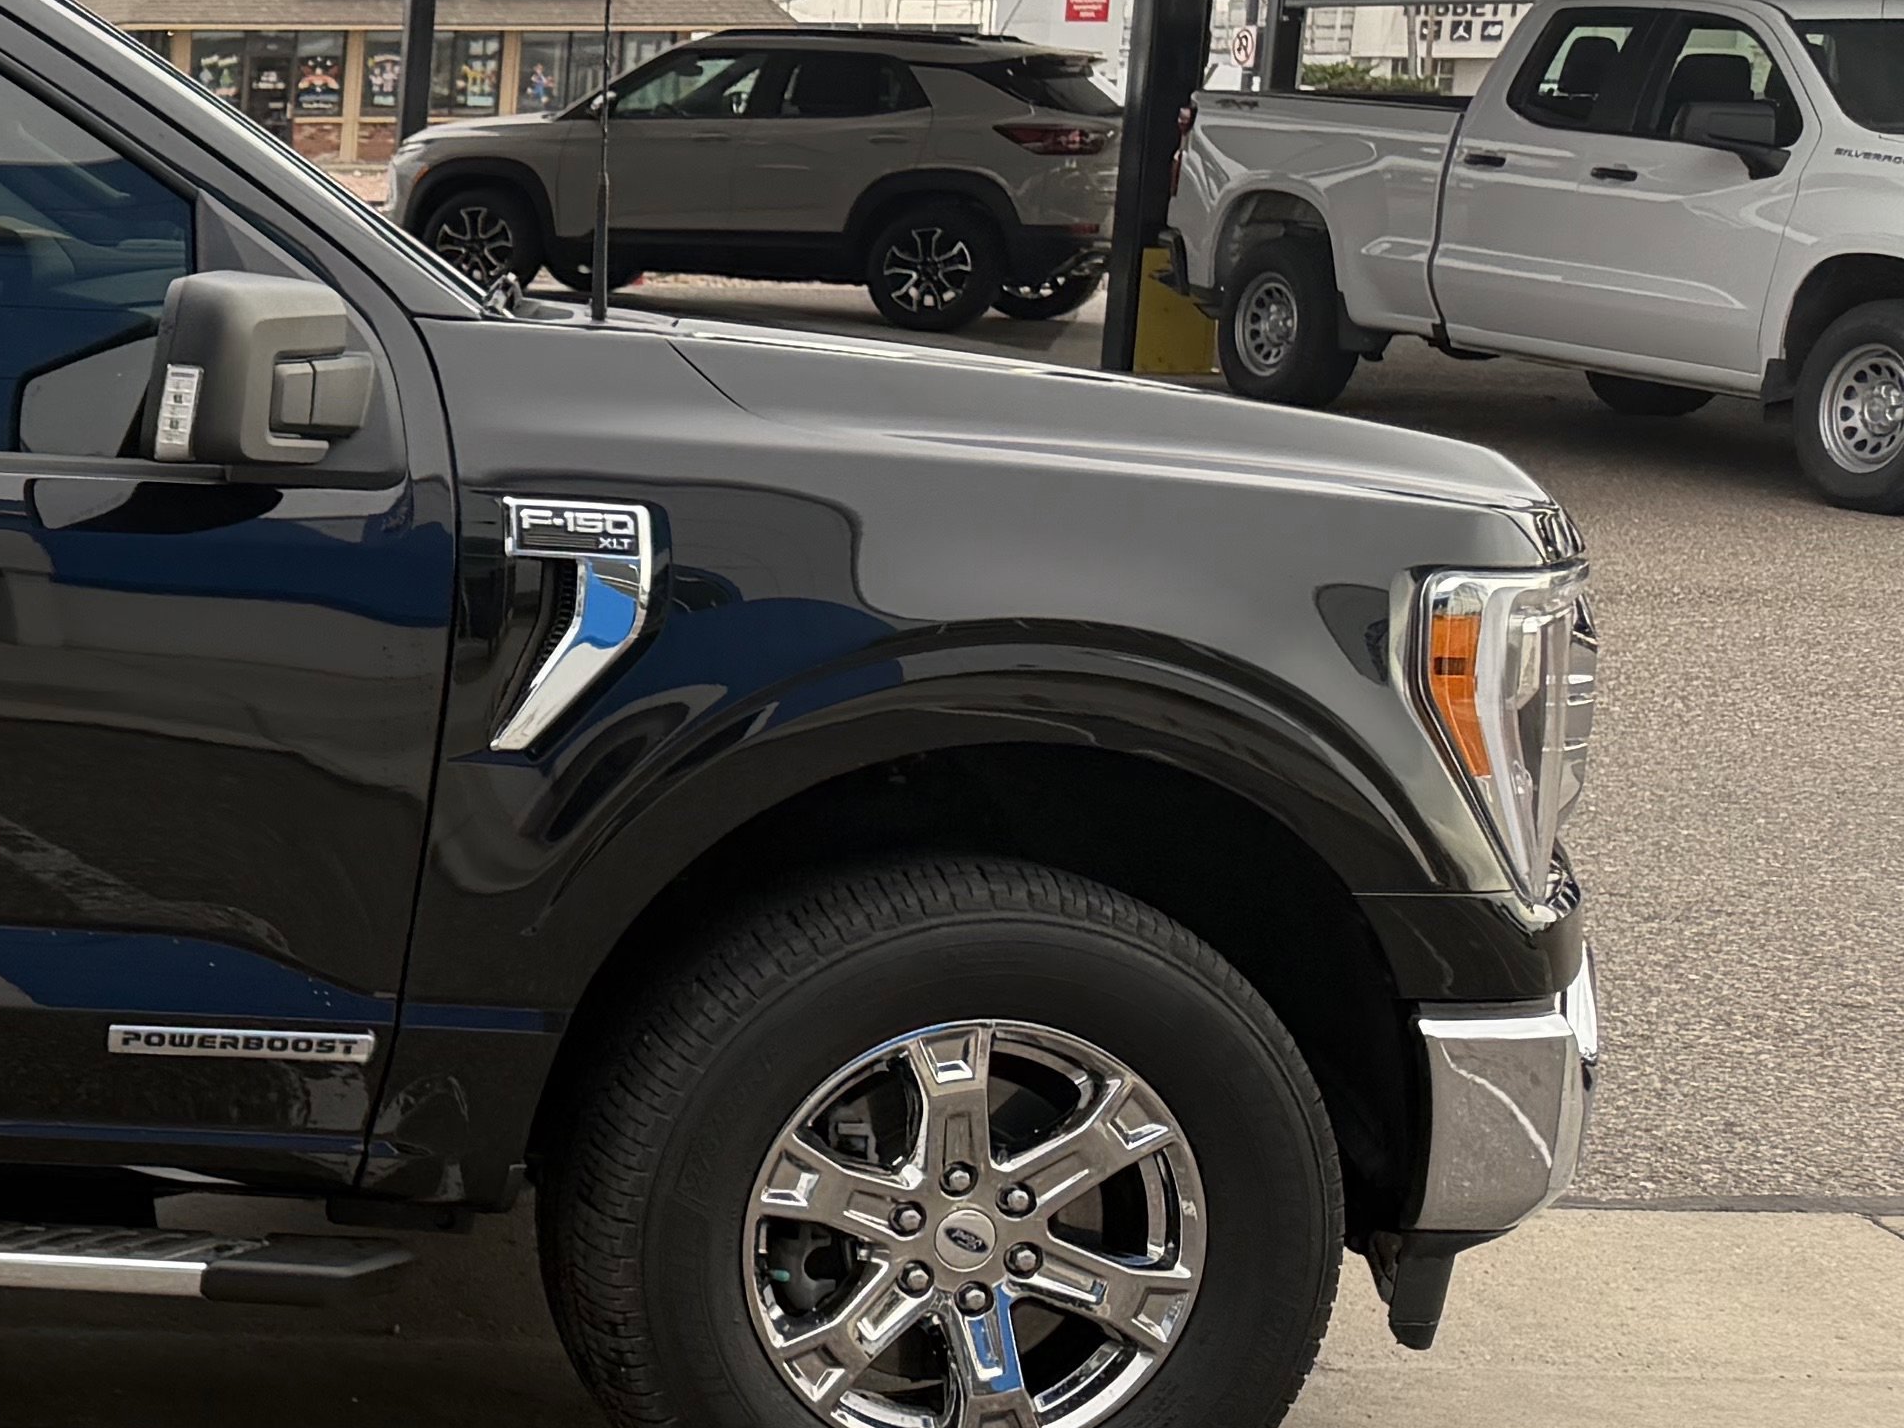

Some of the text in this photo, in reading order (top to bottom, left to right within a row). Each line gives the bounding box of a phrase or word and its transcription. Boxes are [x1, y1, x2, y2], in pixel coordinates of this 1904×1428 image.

[519, 508, 635, 535] F-150
[598, 537, 633, 551] XLT
[121, 1030, 358, 1056] POWERBOOST
